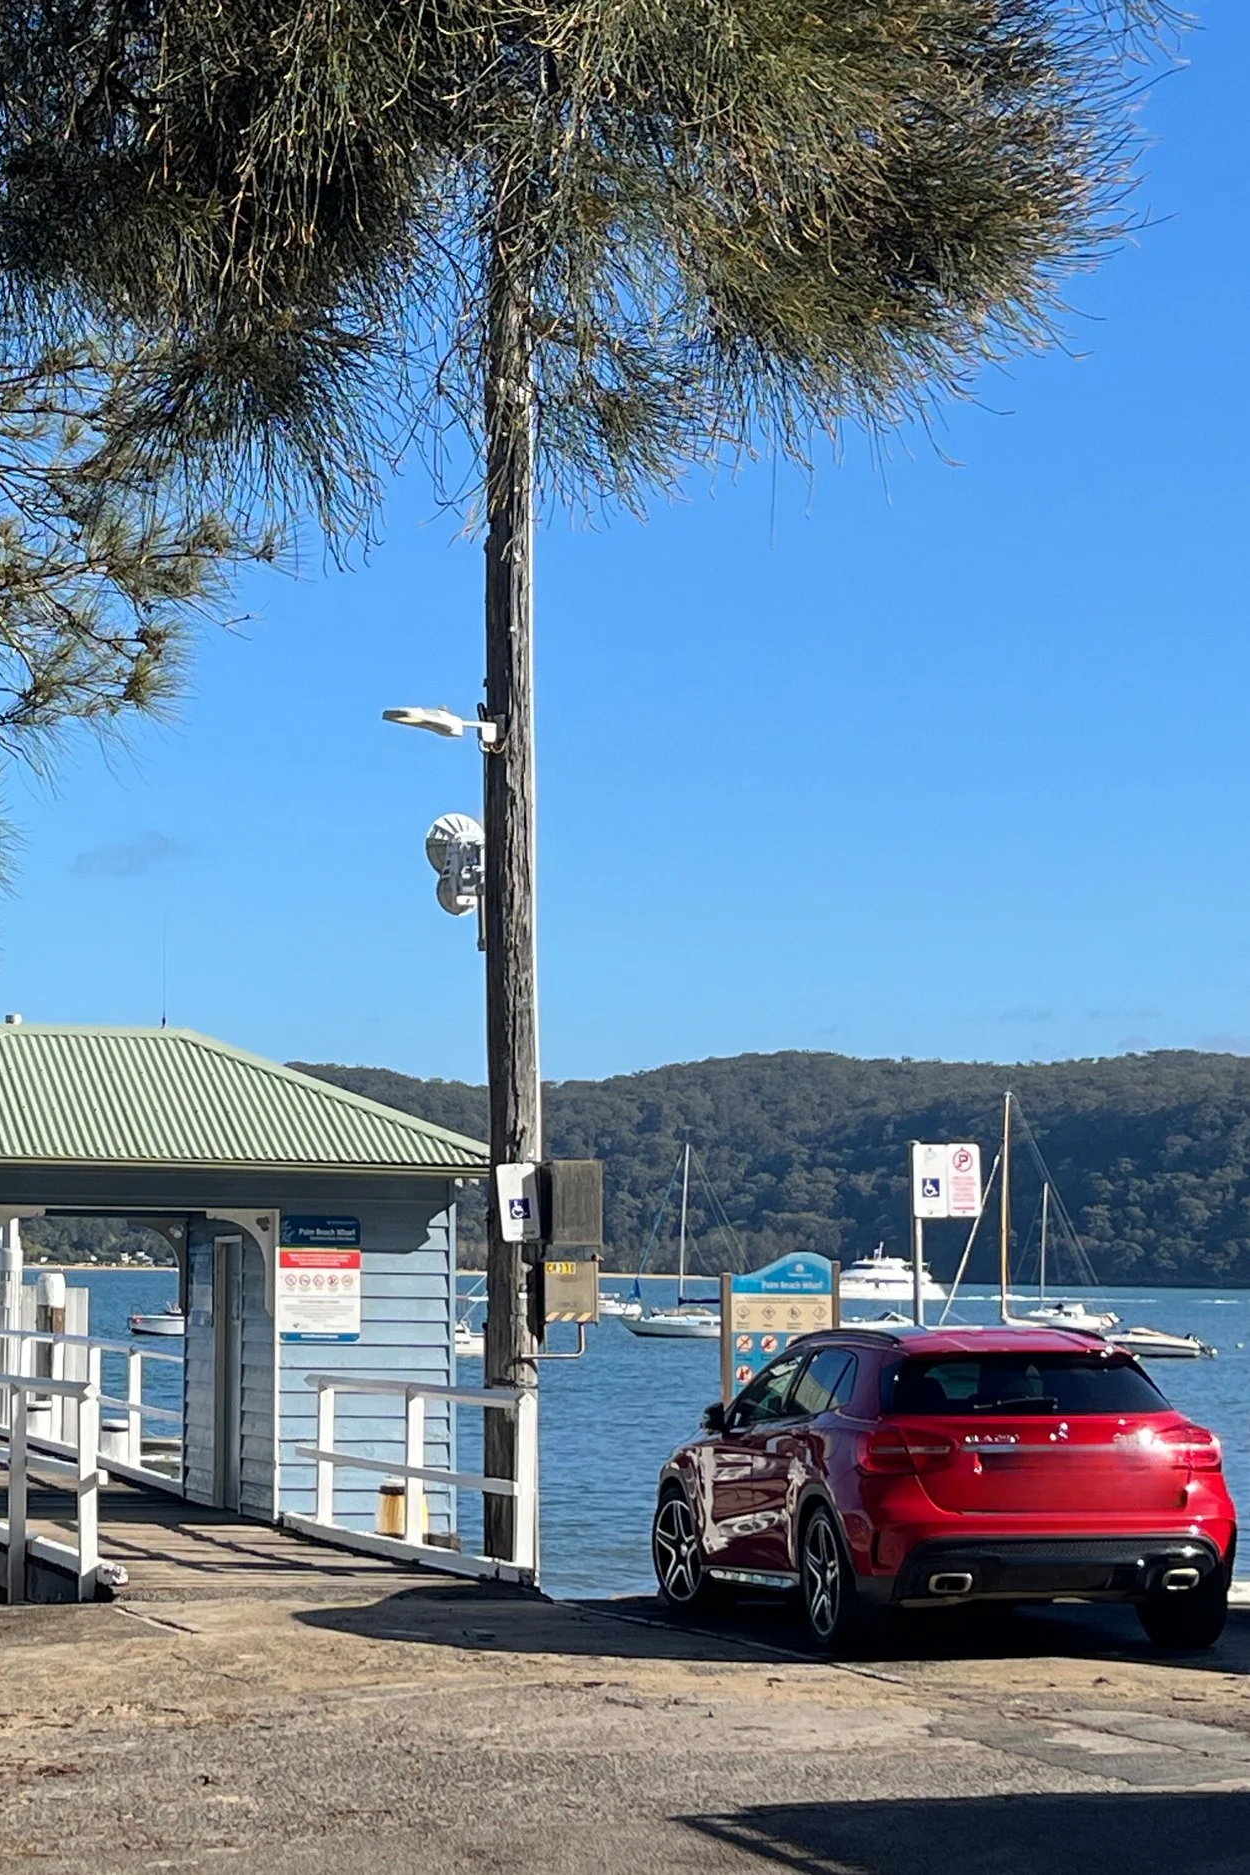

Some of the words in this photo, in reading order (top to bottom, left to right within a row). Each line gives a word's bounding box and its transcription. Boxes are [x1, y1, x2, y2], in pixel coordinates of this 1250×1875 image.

[298, 1227, 315, 1236] Palm
[316, 1227, 336, 1236] Beach
[336, 1228, 356, 1236] Wharf
[761, 1281, 779, 1289] Palm
[780, 1281, 802, 1289] Beach
[802, 1281, 824, 1289] Wharf
